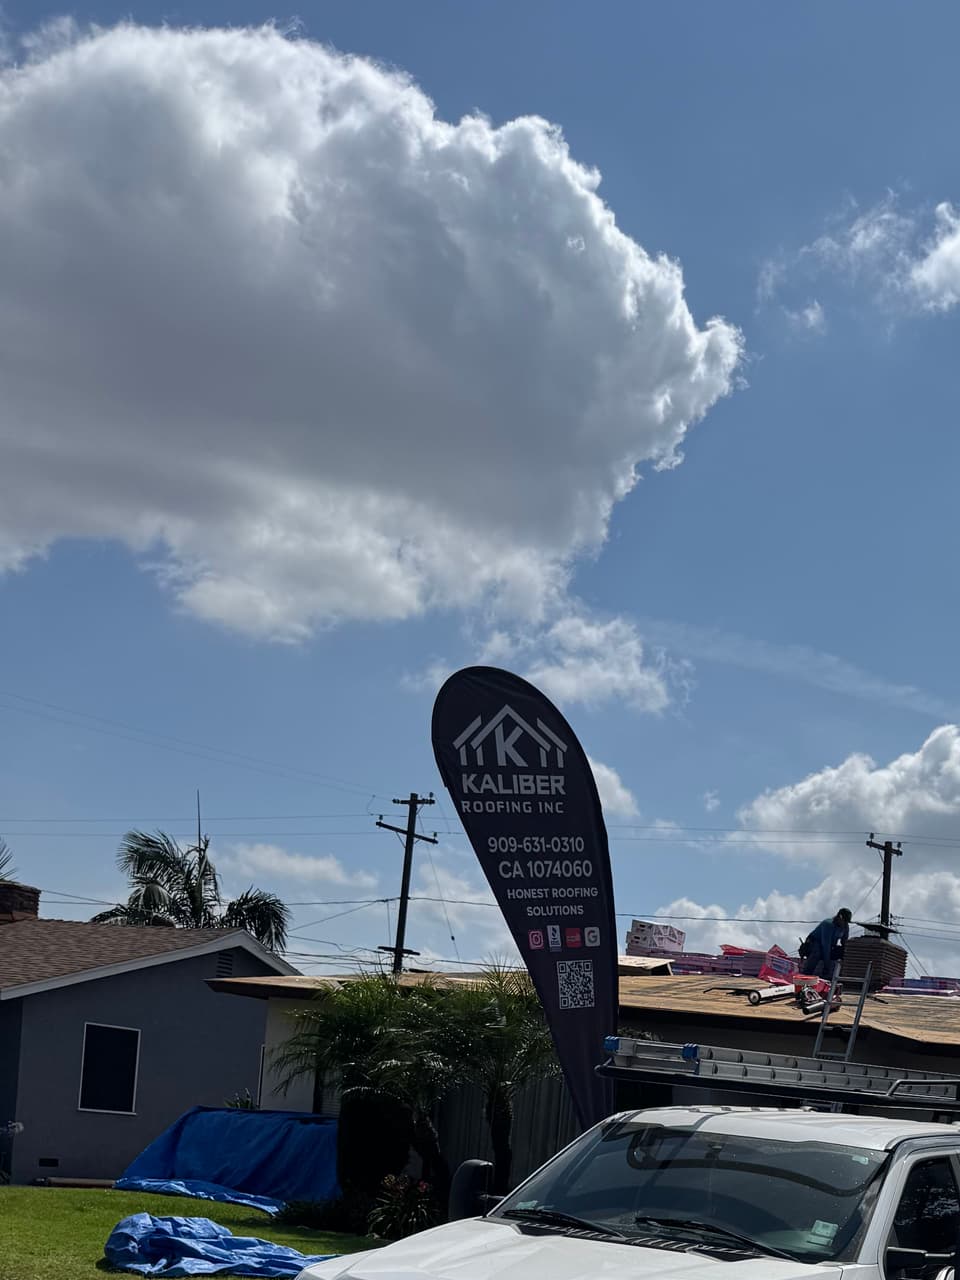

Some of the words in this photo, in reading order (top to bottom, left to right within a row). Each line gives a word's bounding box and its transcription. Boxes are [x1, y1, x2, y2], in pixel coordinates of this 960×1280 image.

[461, 773, 566, 796] KALIBER
[461, 800, 532, 813] ROOFING
[539, 801, 564, 814] INC
[487, 836, 585, 853] 909-631-0310
[499, 861, 524, 878] CA
[527, 859, 593, 878] 1074060
[507, 888, 549, 899] HONEST
[552, 887, 599, 898] ROOFING
[526, 905, 585, 917] SOLUTIONS
